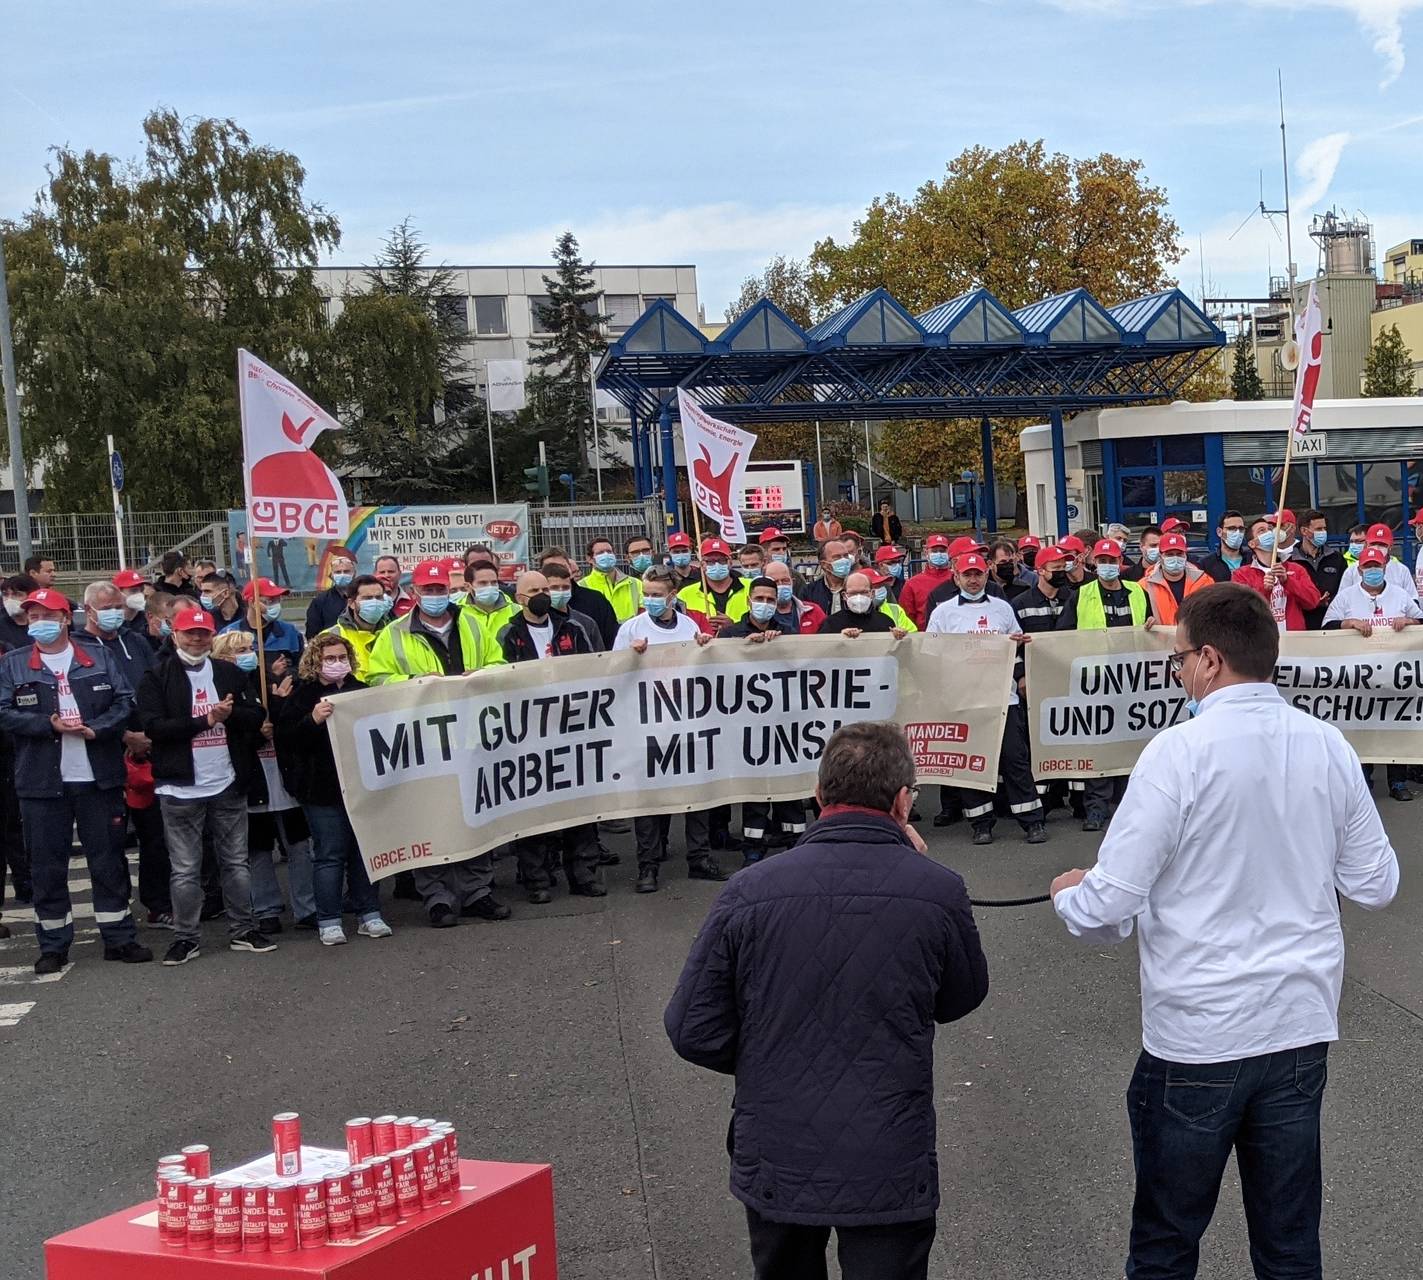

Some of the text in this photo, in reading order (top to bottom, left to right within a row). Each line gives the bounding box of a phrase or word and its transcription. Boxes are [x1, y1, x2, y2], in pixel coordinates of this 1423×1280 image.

[377, 513, 484, 528] ALLES WIRD GUT!
[369, 528, 446, 541] WIR SIND DA
[487, 525, 517, 535] JETZT
[392, 542, 414, 554] MIT
[1049, 704, 1115, 737] UND
[368, 713, 457, 777] MIT
[478, 687, 616, 752] GUTER
[907, 724, 964, 740] WANDEL
[915, 754, 964, 767] ESTALTEN
[1038, 759, 1094, 773] IGBCE.DE
[474, 739, 621, 815] ARBEIT.
[646, 727, 721, 778] MIT
[369, 841, 433, 873] IGBCE.DE
[395, 1180, 410, 1190] FAIR
